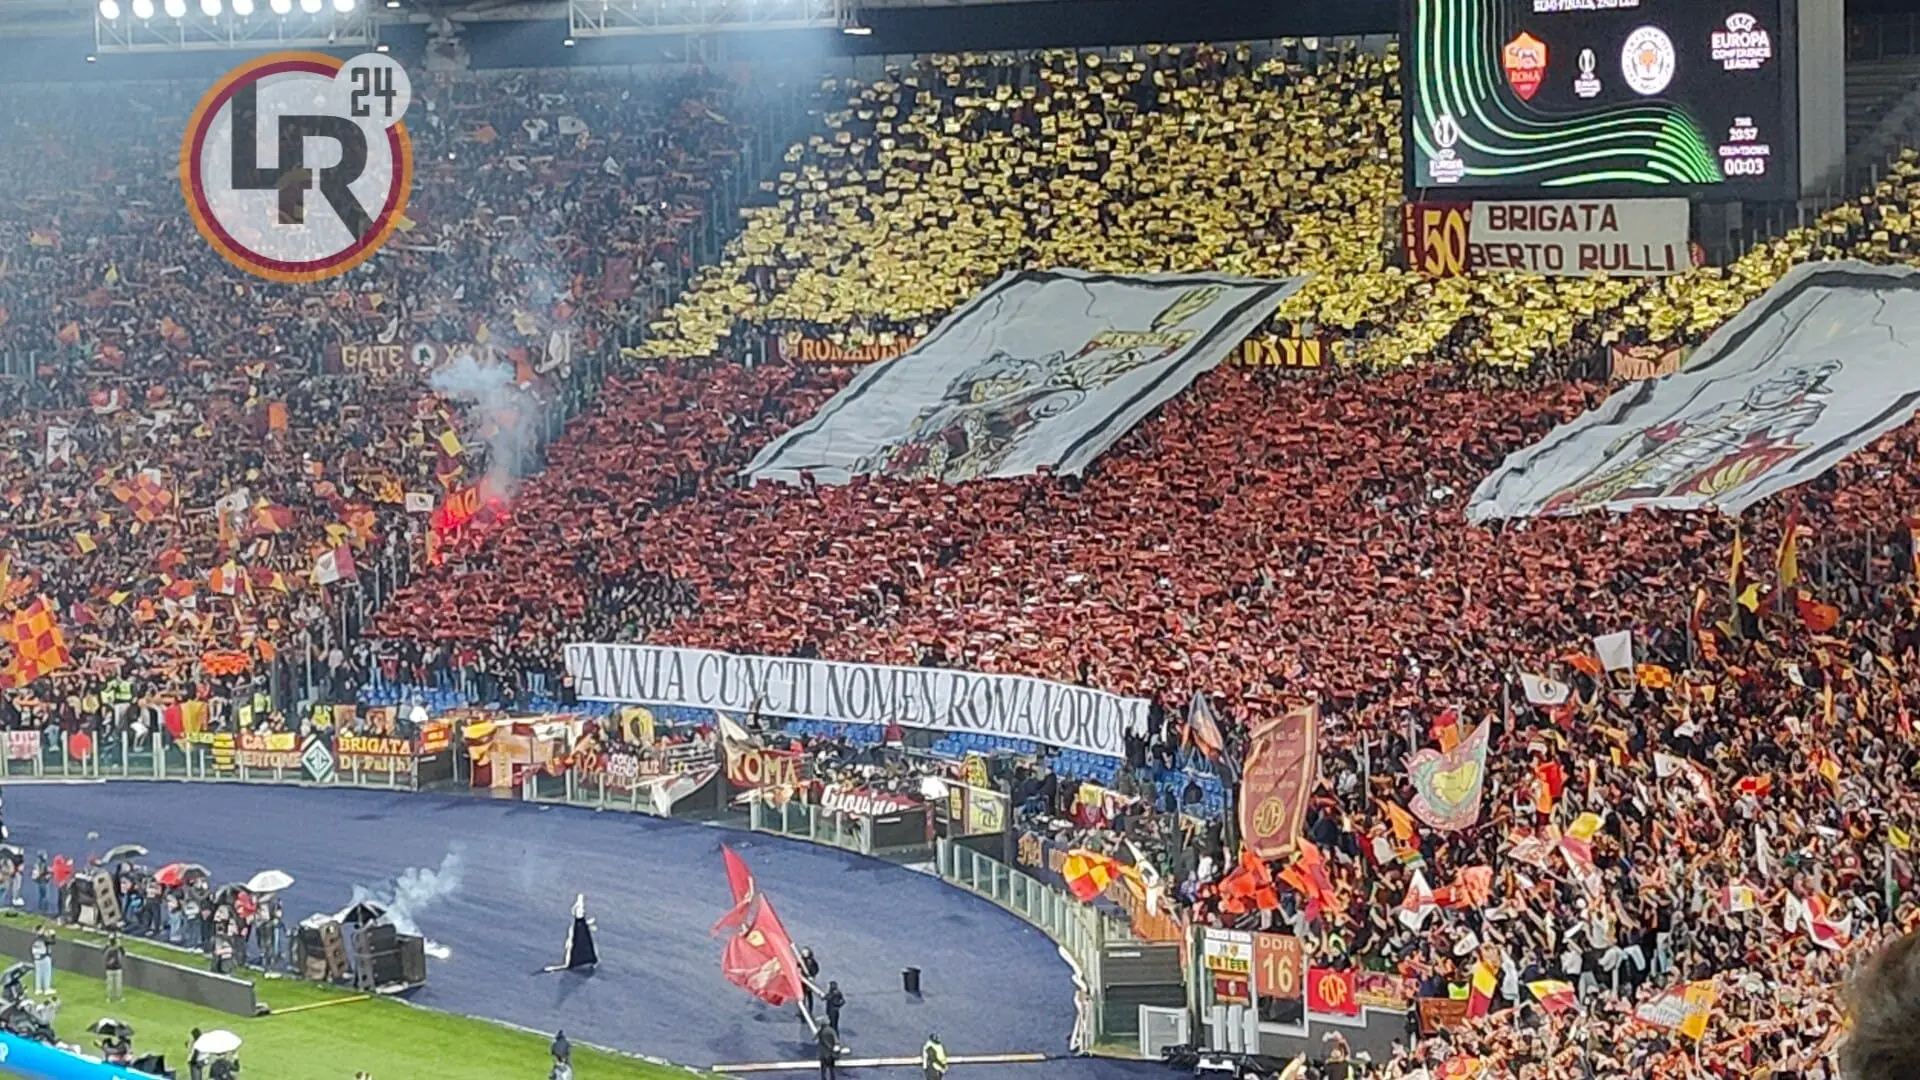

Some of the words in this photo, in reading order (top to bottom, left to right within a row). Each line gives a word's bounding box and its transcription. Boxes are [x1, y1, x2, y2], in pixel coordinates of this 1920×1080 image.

[1711, 31, 1770, 49] EUROPA
[1724, 158, 1765, 176] 00:03
[1488, 204, 1618, 232] BRIGATA
[1579, 243, 1675, 272] RULLI
[341, 345, 404, 368] GATE
[697, 653, 814, 714] CUNCTI
[825, 664, 944, 725] NOMEN
[337, 736, 412, 754] BRIGATA
[727, 750, 798, 787] ROMA
[1259, 936, 1296, 952] DDR
[1262, 953, 1294, 993] 16
